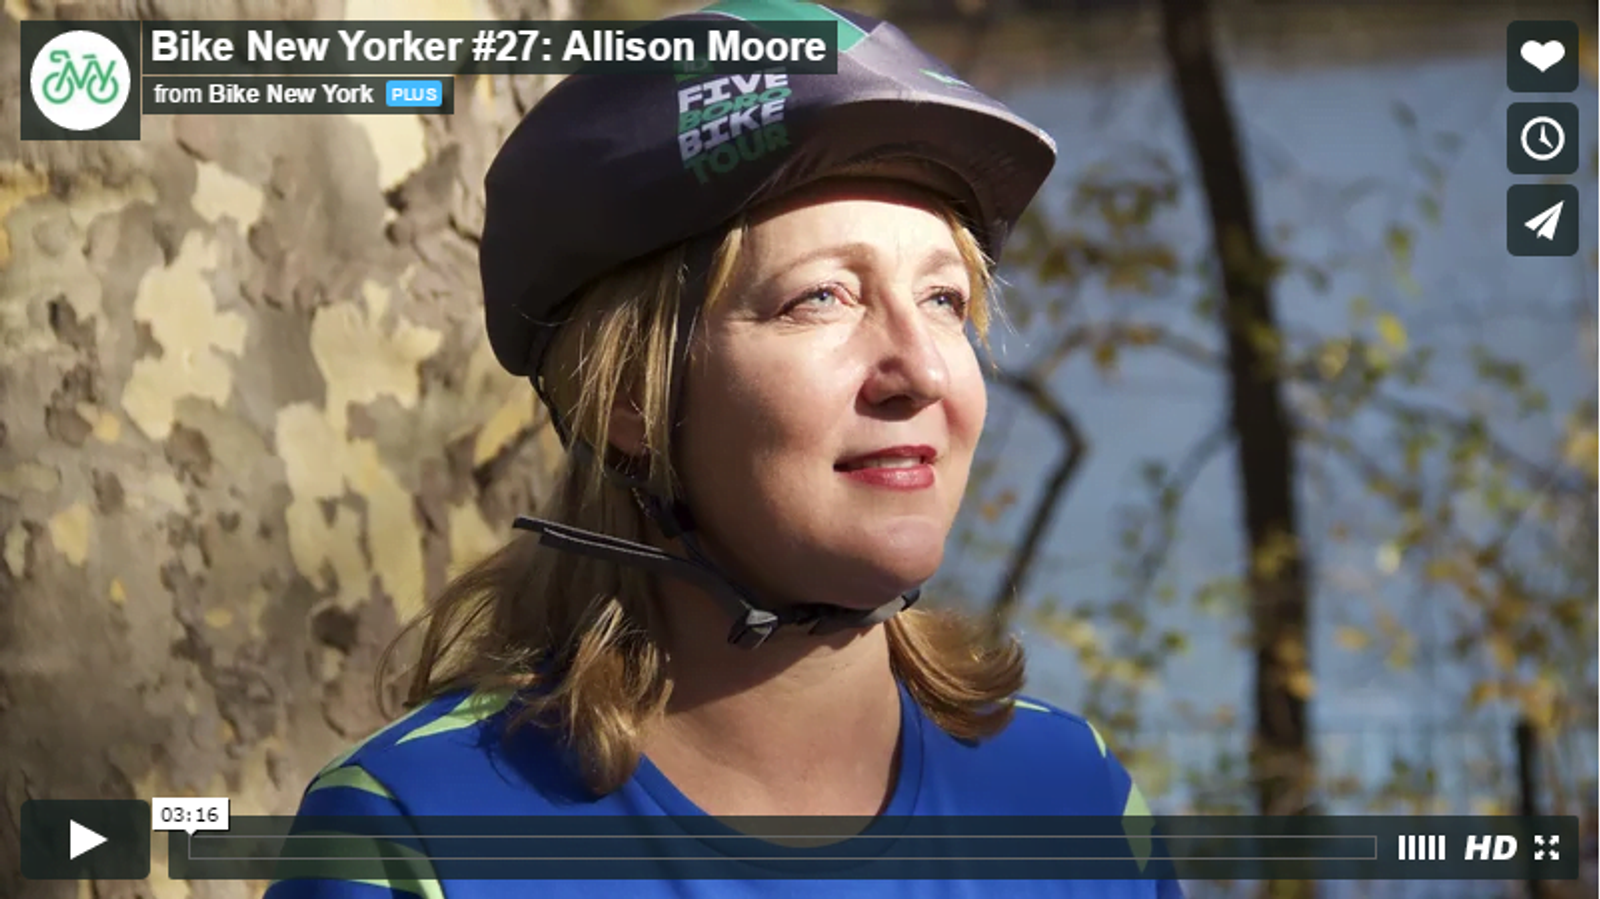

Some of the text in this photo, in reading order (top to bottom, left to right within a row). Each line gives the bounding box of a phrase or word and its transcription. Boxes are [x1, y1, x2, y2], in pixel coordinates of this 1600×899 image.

[677, 67, 788, 113] FIVE
[678, 87, 792, 133] BORO
[677, 98, 786, 161] BIKE
[684, 123, 791, 184] TOUR
